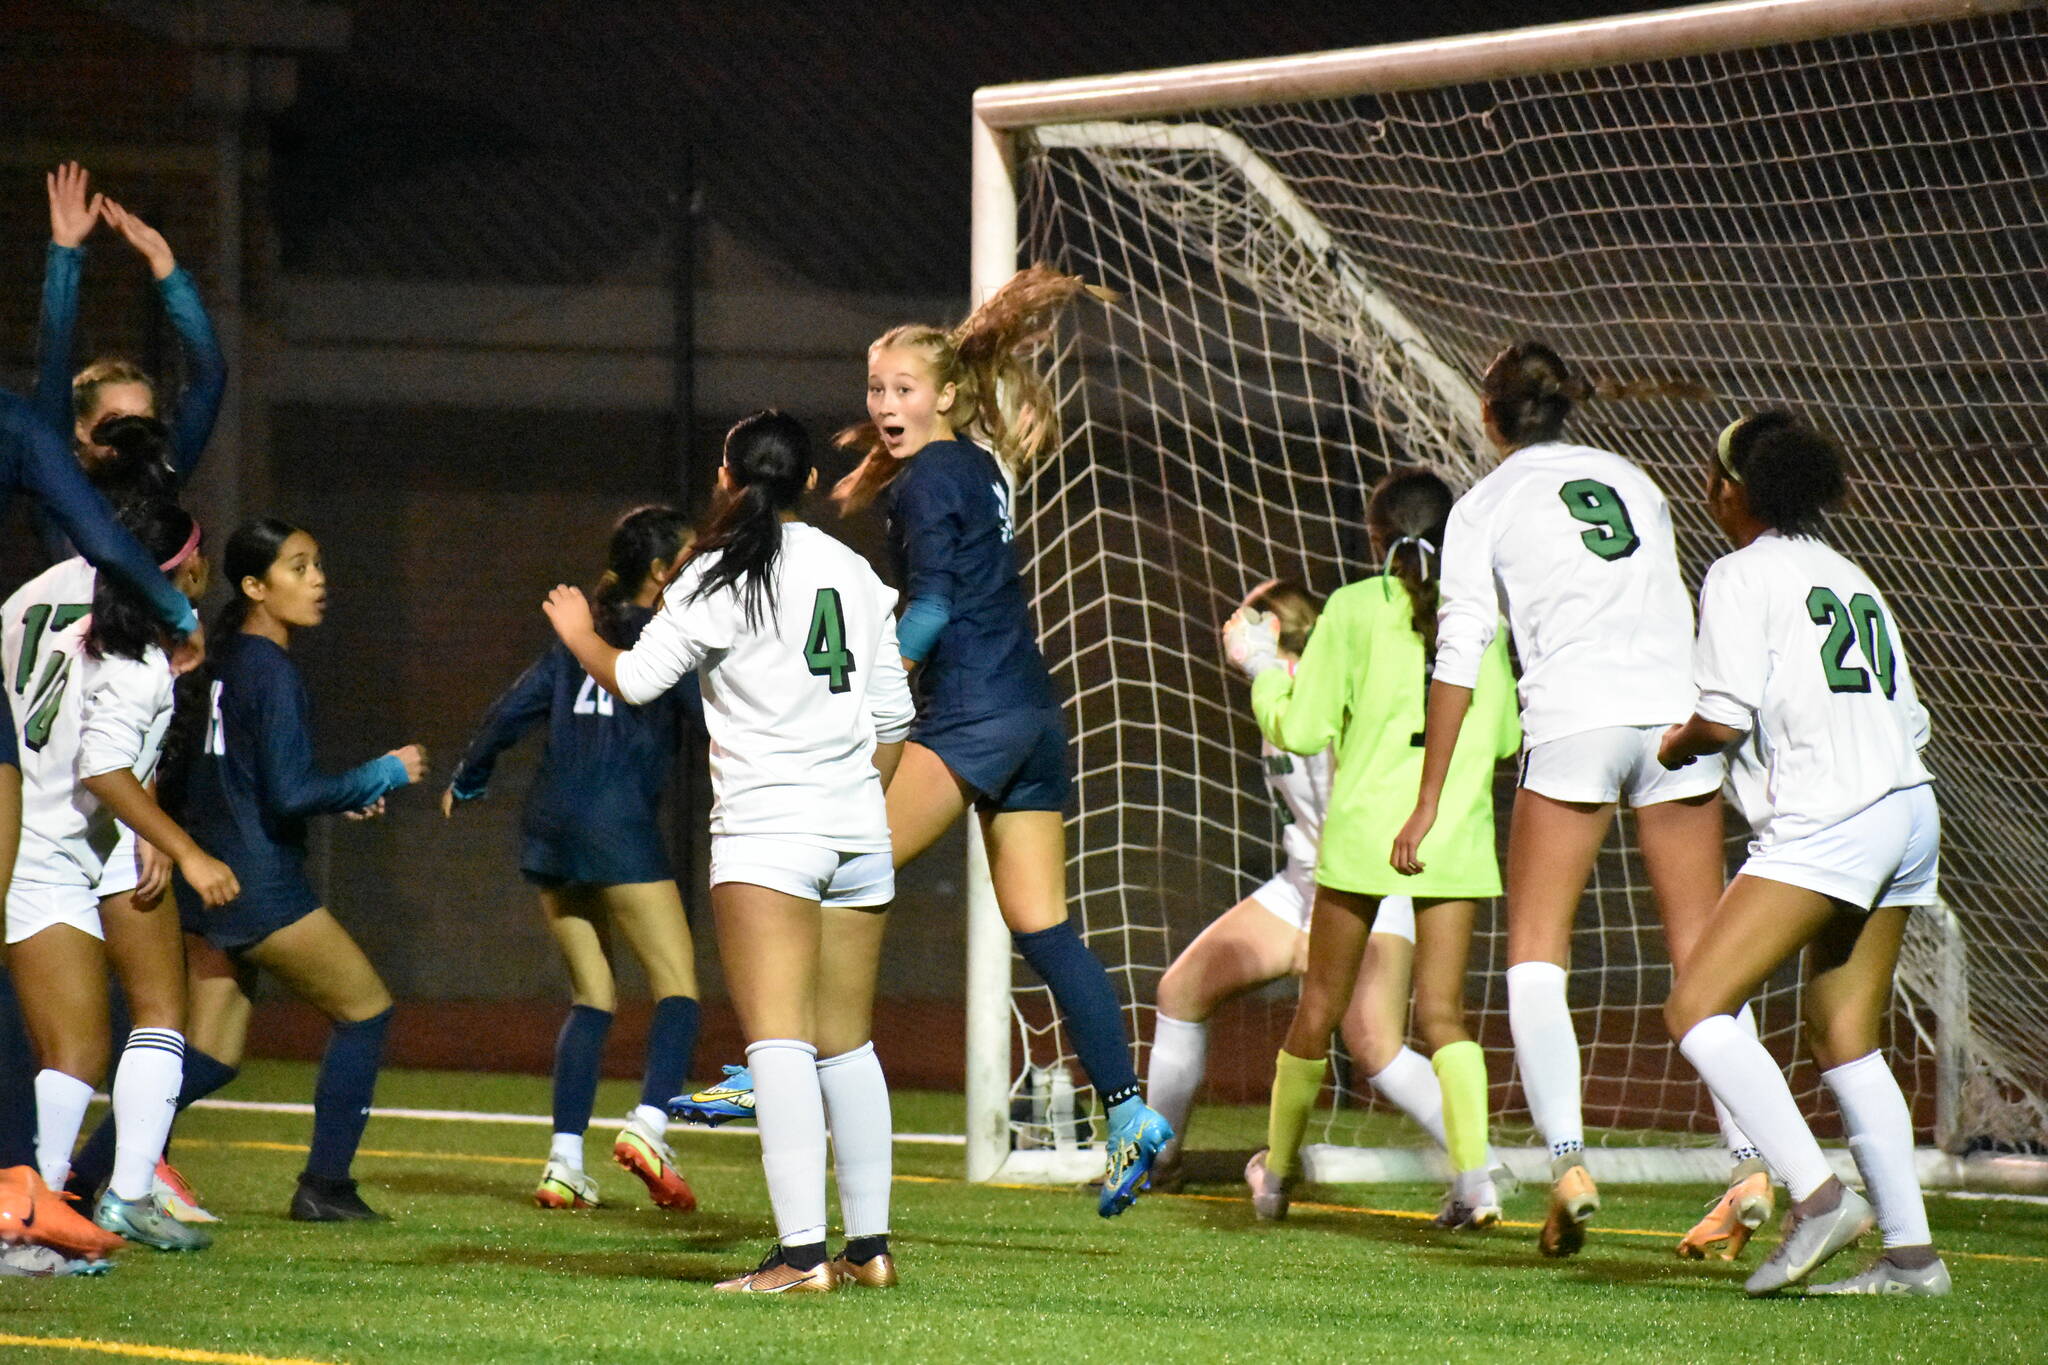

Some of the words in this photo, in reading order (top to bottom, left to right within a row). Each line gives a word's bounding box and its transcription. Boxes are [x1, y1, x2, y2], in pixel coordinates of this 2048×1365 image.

[1558, 478, 1641, 562] 9
[803, 588, 857, 695] 4
[1806, 586, 1897, 701] 20
